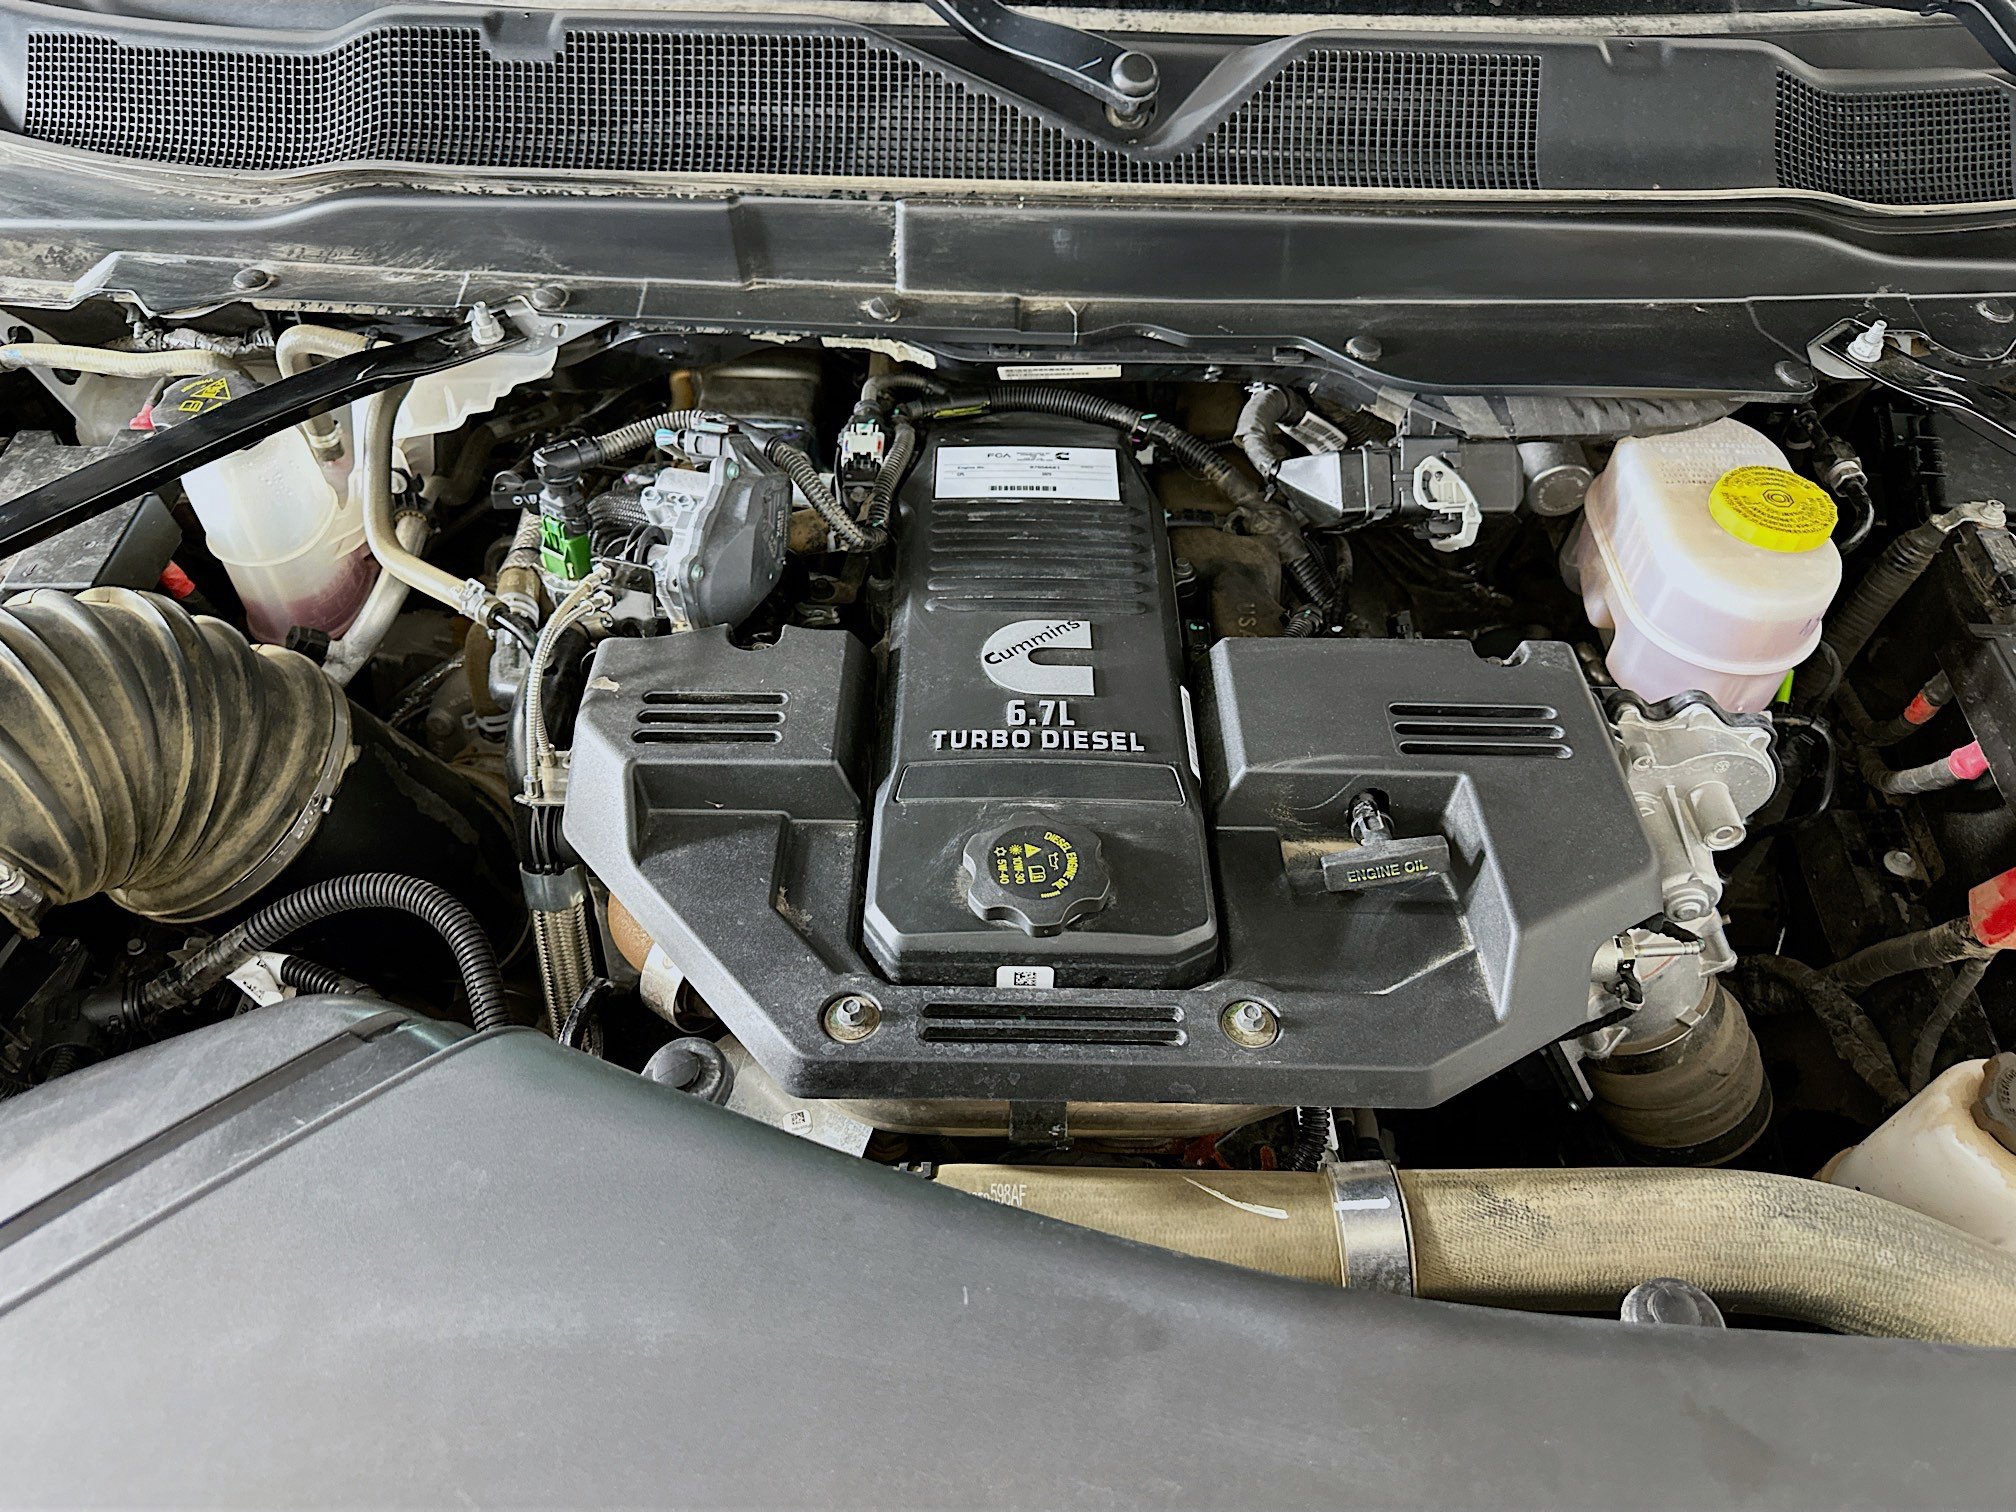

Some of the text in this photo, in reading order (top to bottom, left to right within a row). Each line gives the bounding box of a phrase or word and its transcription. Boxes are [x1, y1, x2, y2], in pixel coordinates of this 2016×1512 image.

[984, 620, 1080, 665] Cummins
[1007, 699, 1075, 726] 6.7L
[931, 729, 1145, 752] TURBO DIESEL
[996, 858, 1010, 885] 5W-40
[1012, 855, 1026, 885] 10W-30
[1044, 831, 1079, 890] DIESEL ENGINE OIL
[1346, 859, 1429, 883] ENGINE OIL
